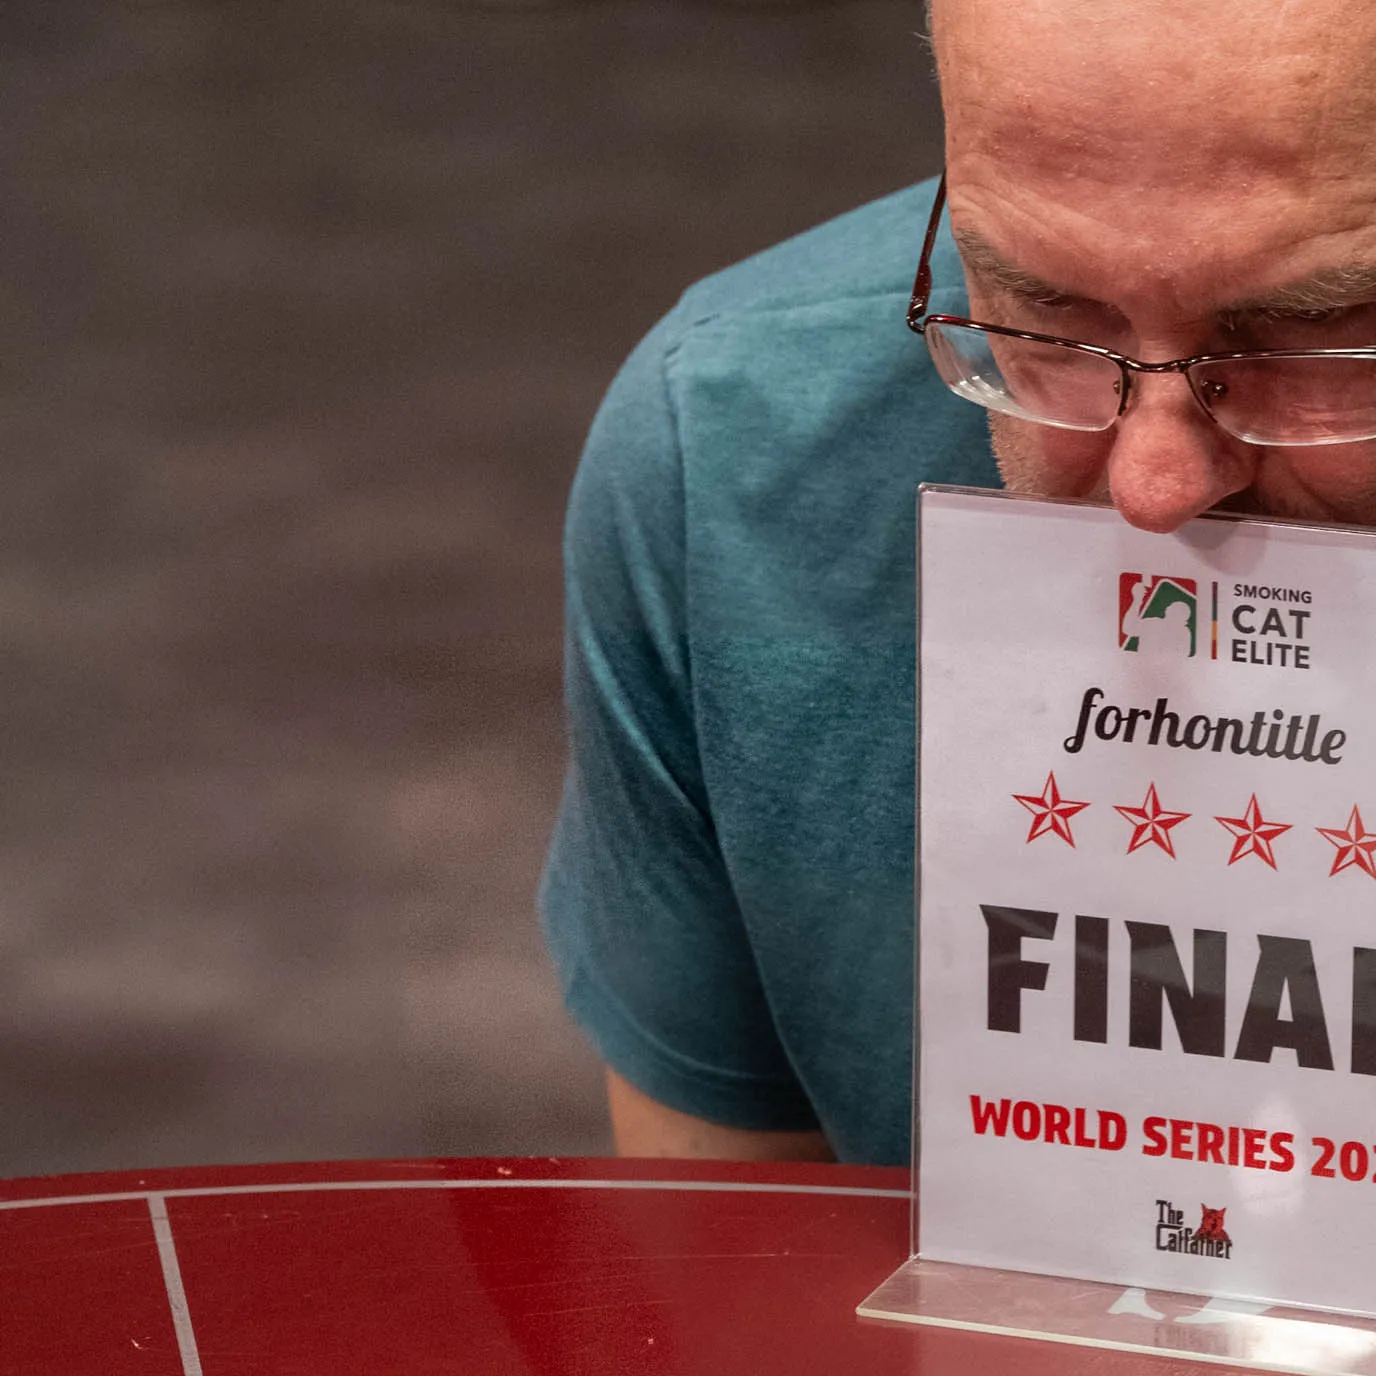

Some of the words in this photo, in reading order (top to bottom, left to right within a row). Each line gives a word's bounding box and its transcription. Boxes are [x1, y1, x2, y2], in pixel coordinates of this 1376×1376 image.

[1233, 583, 1312, 604] SMOKING
[1231, 604, 1311, 639] CAT
[1231, 639, 1310, 669] ELITE
[1063, 687, 1346, 766] forhontitle
[969, 1094, 1128, 1152] WORLD
[1142, 1115, 1295, 1173] SERIES
[1156, 1199, 1184, 1225] The
